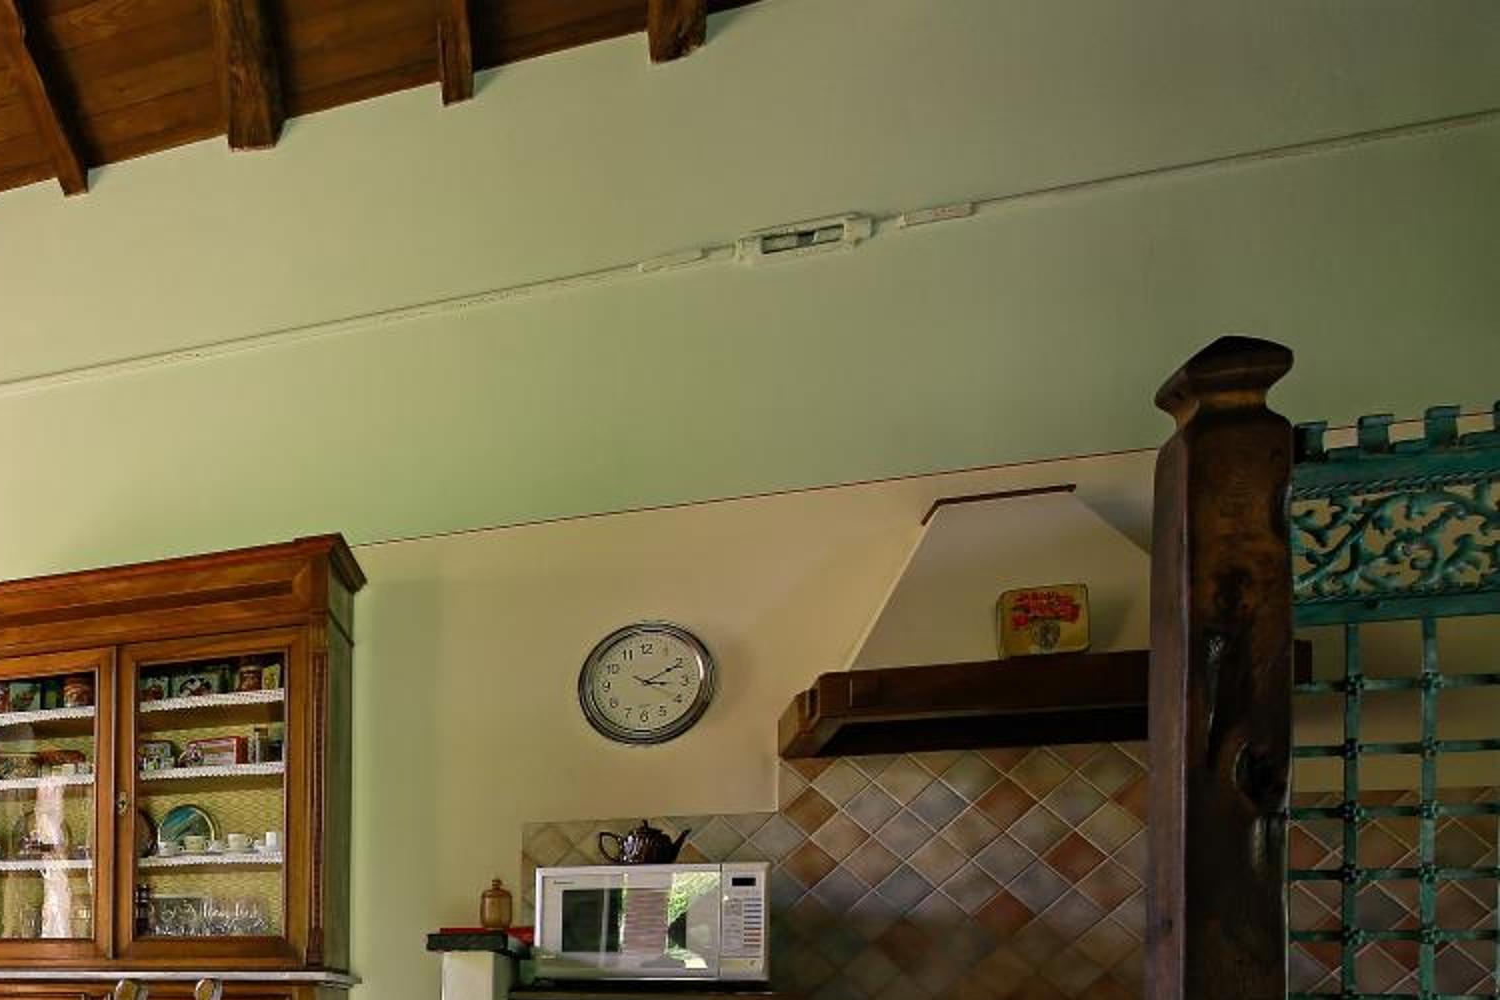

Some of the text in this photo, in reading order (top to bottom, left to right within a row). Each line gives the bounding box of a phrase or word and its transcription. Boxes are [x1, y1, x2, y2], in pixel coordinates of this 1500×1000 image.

[640, 643, 652, 654] 12
[622, 649, 633, 661] 11
[606, 664, 619, 674] 10
[680, 675, 689, 686] 3
[602, 681, 611, 693] 9
[624, 707, 633, 719] 7
[640, 711, 649, 722] 6
